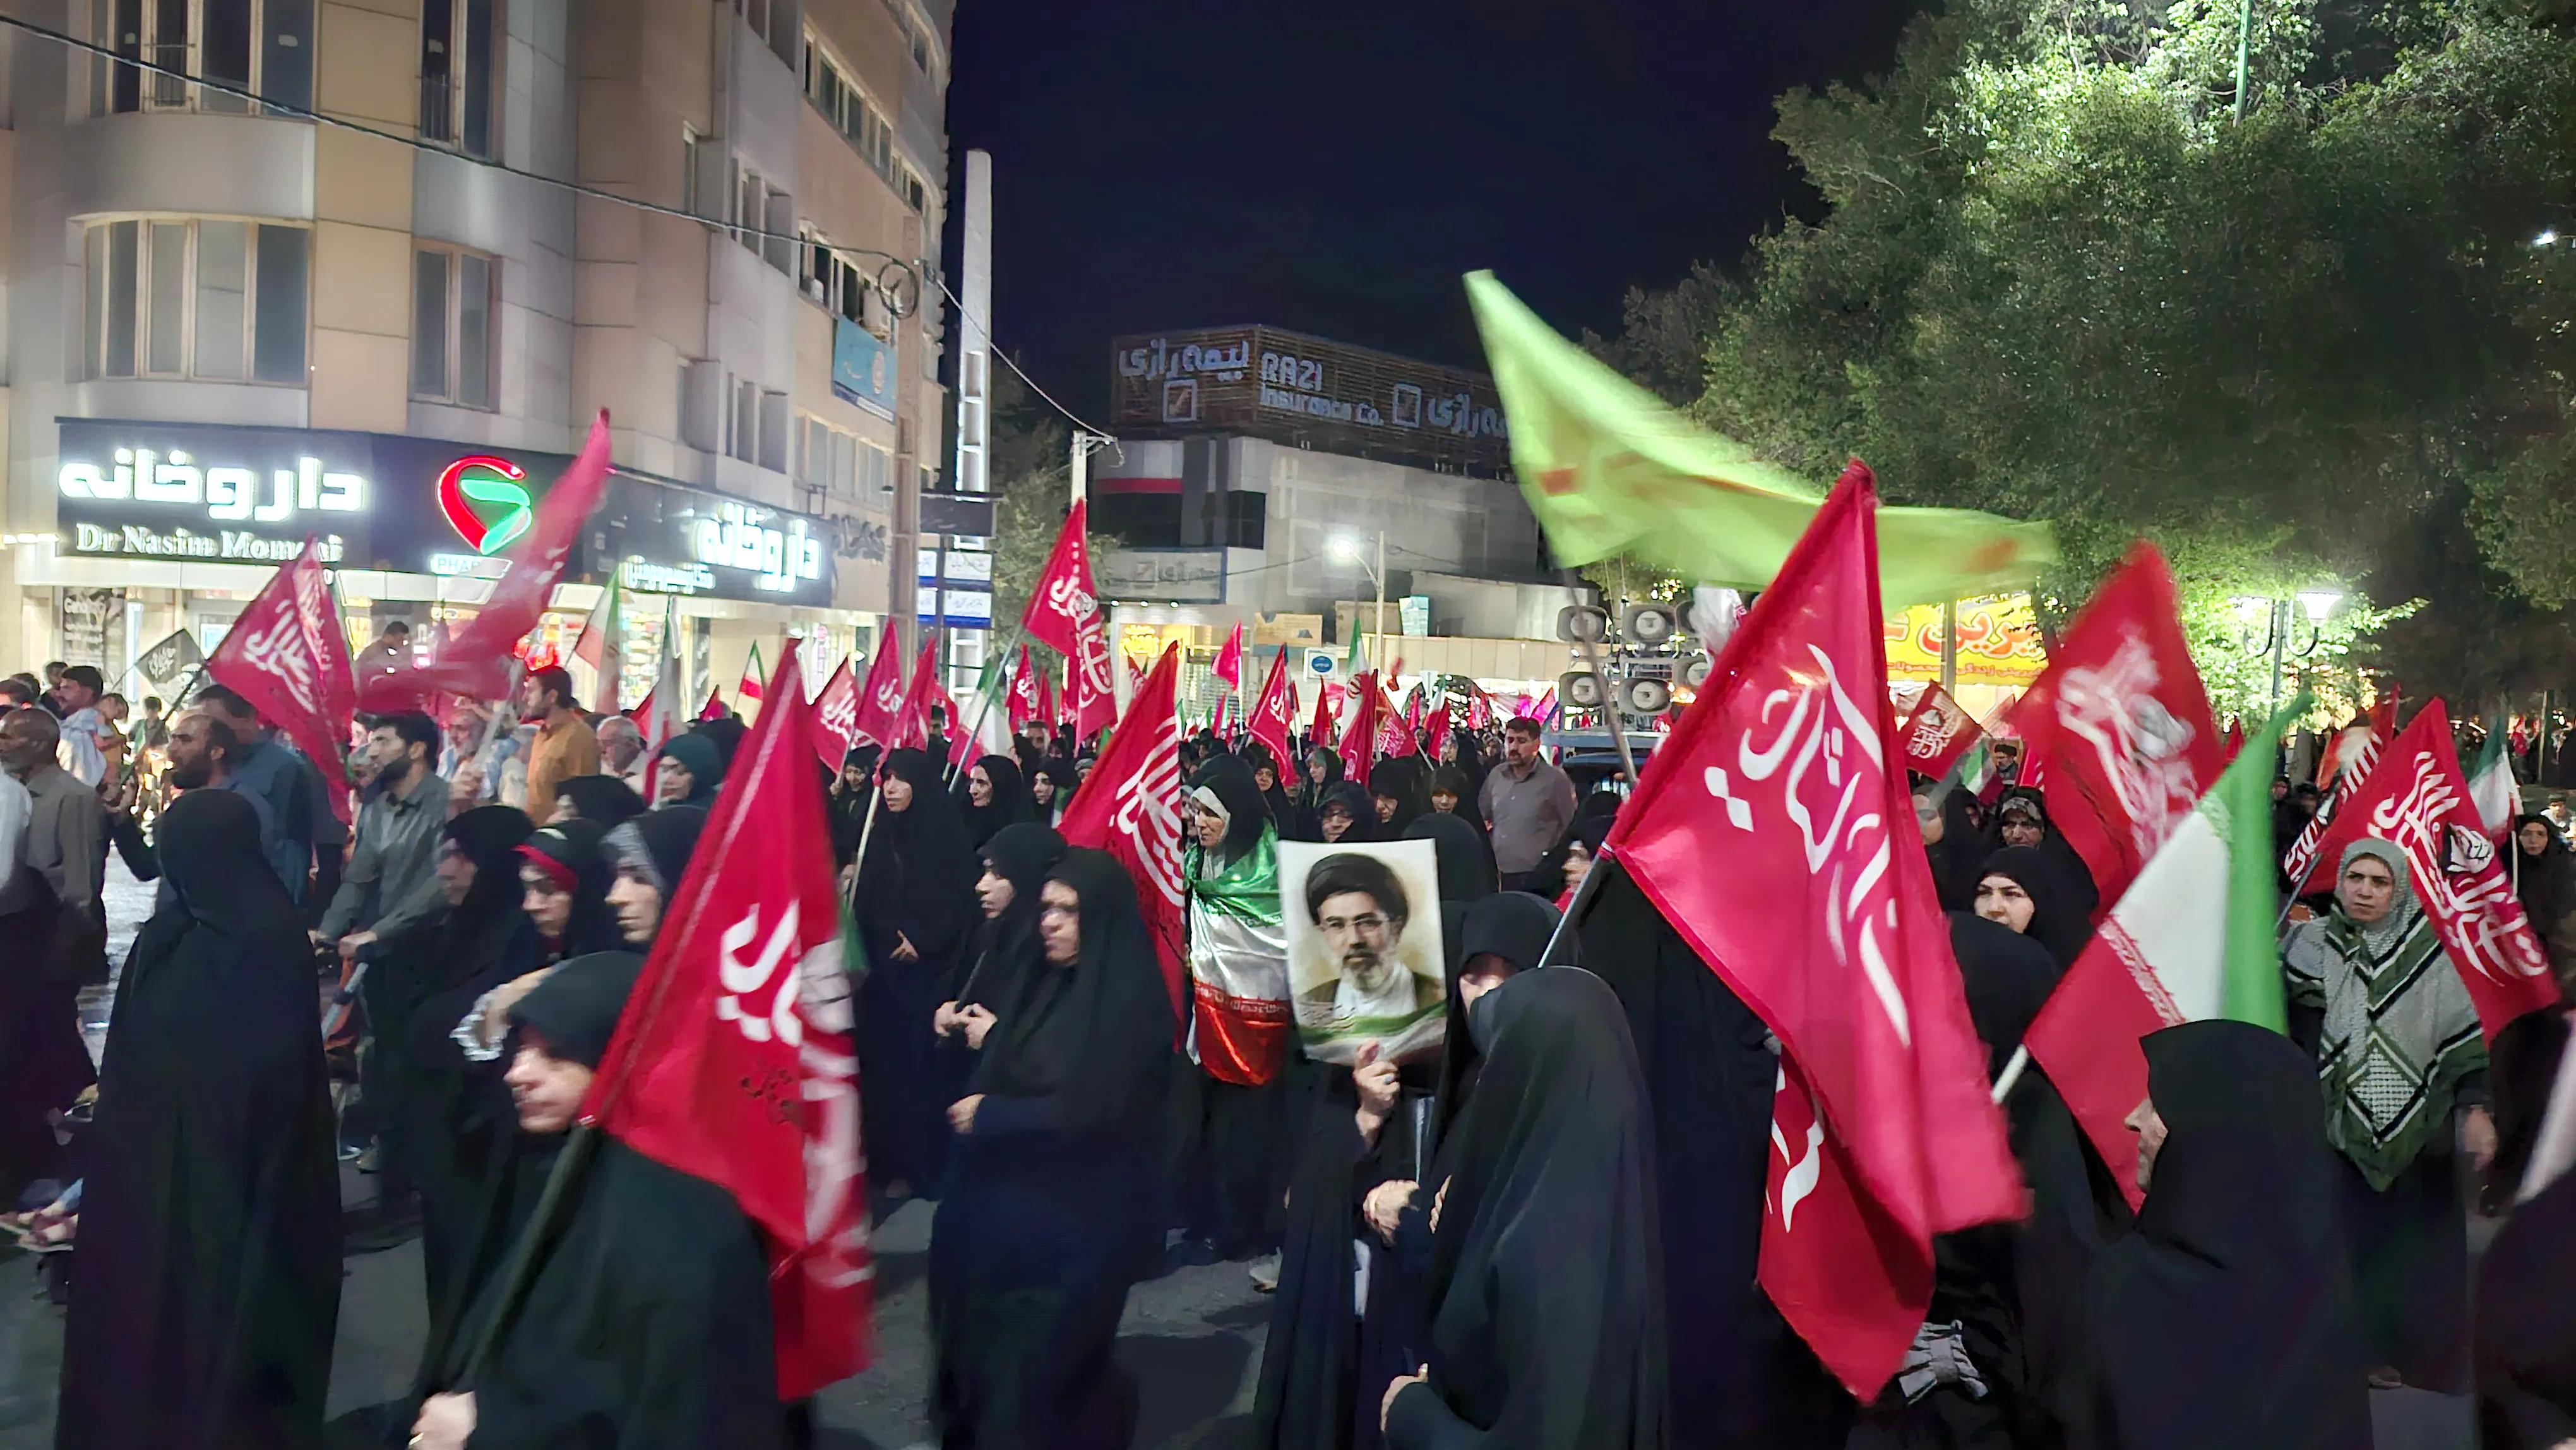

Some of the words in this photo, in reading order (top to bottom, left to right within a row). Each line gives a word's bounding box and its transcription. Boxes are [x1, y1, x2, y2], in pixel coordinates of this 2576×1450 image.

[1261, 352, 1323, 392] RAZI
[58, 448, 367, 522] داروخانه
[76, 522, 119, 553] Dr
[122, 525, 217, 558] Nasim
[697, 501, 821, 593] داروخانه
